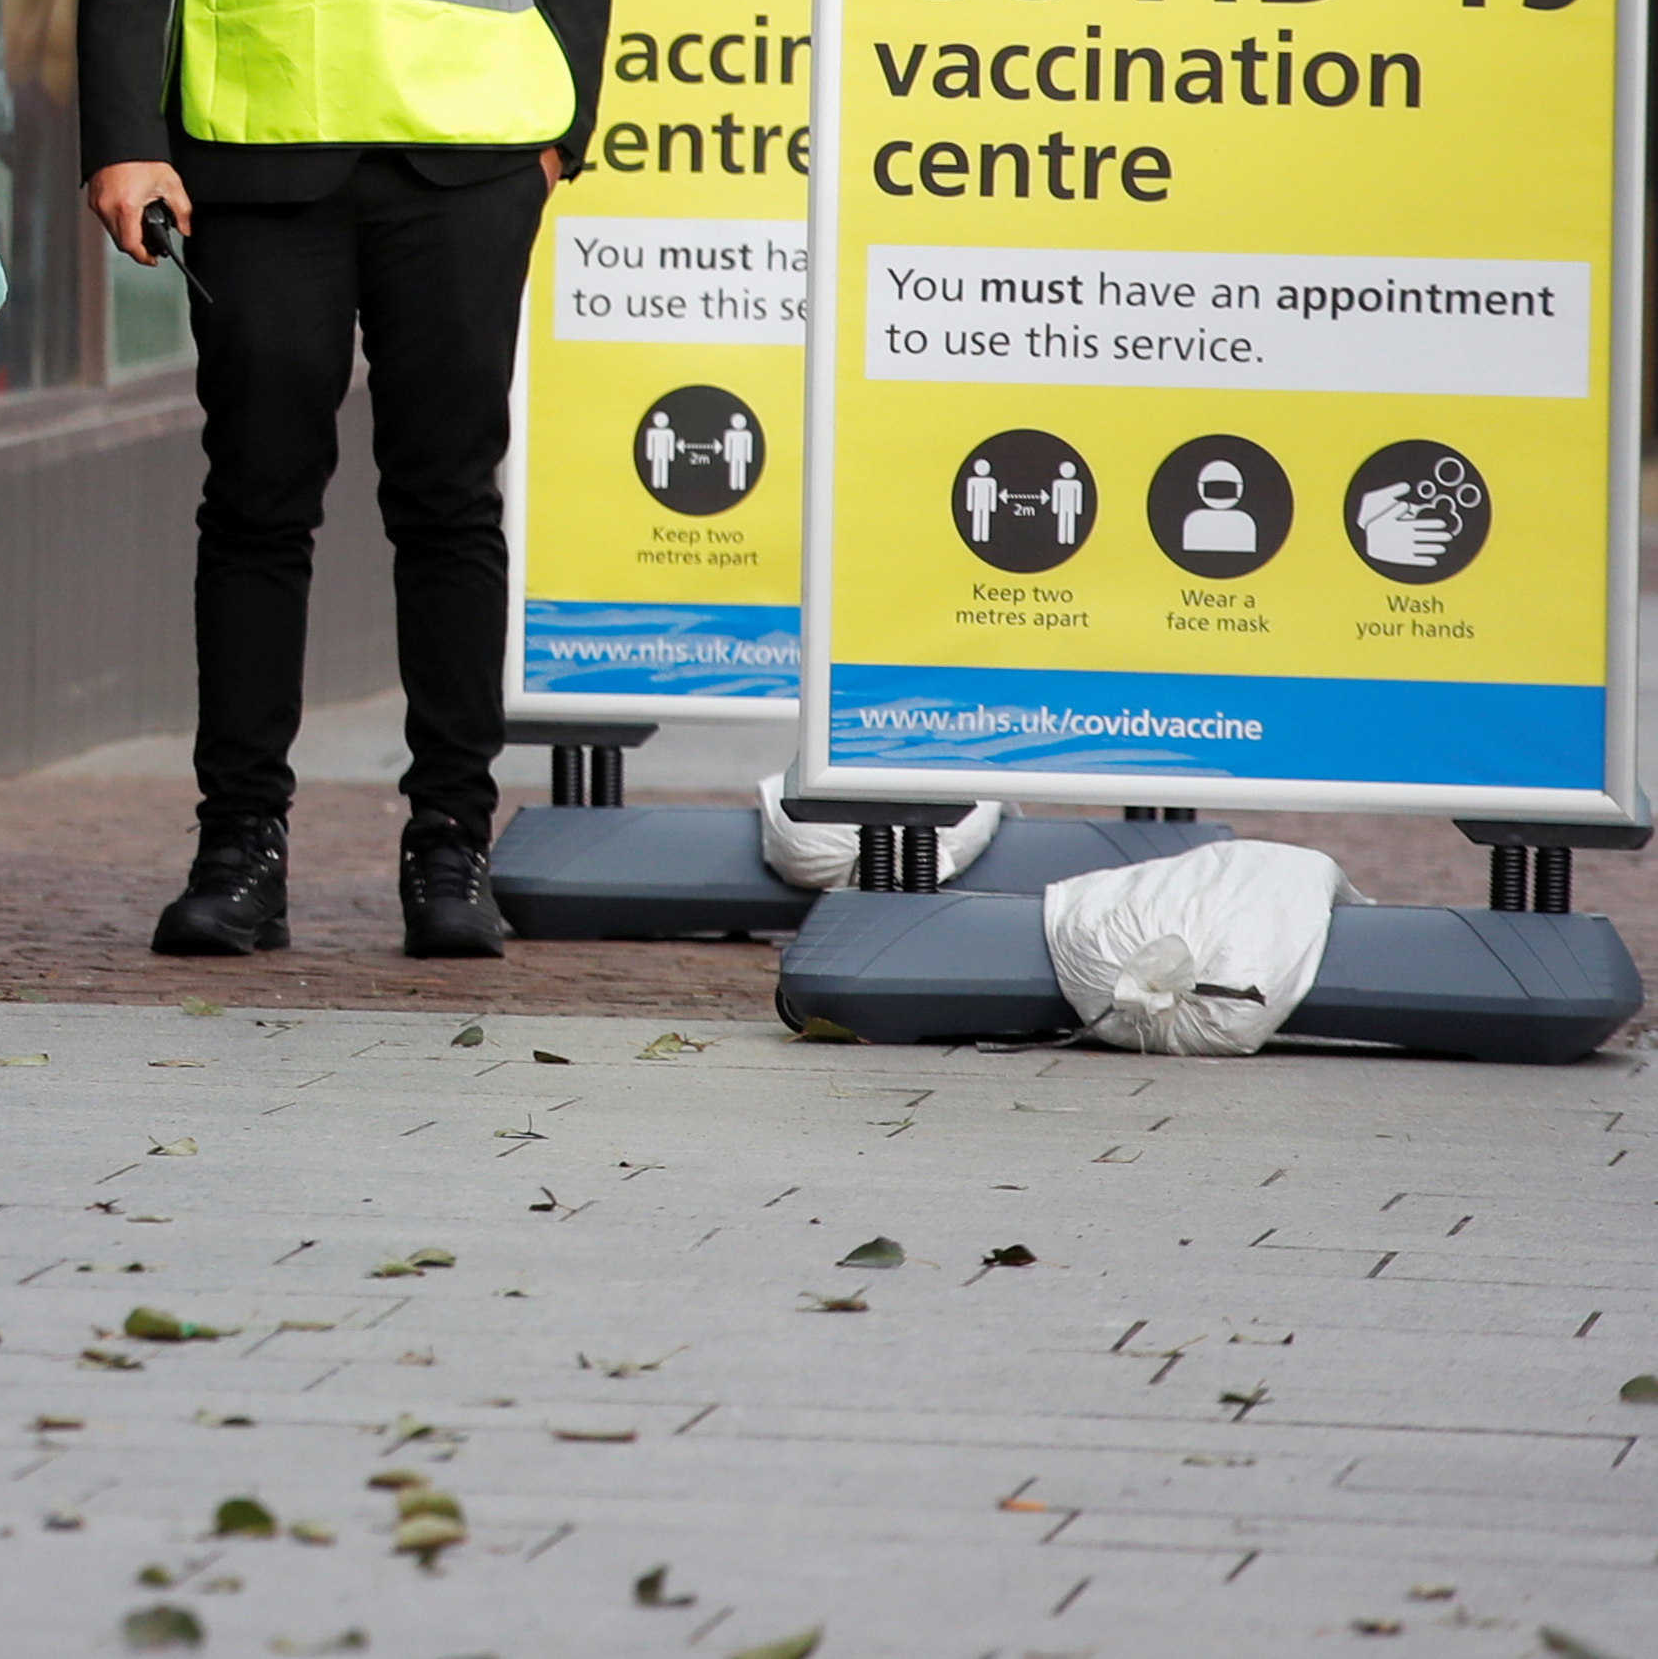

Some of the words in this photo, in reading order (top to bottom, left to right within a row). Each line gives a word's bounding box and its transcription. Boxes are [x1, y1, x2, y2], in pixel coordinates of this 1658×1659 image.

[614, 13, 812, 85] accin
[873, 24, 1423, 110] vaccination
[872, 131, 1173, 202] centre
[573, 236, 644, 269] You
[659, 242, 754, 271] must
[571, 288, 612, 318] to
[626, 293, 687, 319] use
[699, 286, 768, 321] this
[886, 267, 964, 302] You
[981, 274, 1084, 305] must
[1098, 270, 1196, 308] have
[1210, 281, 1261, 310] an
[1276, 277, 1556, 320] appointment
[885, 323, 929, 355] to
[944, 328, 1011, 357] use
[1024, 322, 1100, 360] this
[1112, 327, 1264, 364] service.
[689, 451, 711, 466] 2m
[1012, 503, 1036, 517] 2m
[652, 525, 701, 546] Keep
[707, 527, 744, 544] two
[636, 548, 702, 566] metres
[708, 550, 759, 569] apart
[972, 583, 1026, 606] Keep
[1032, 586, 1074, 604] two
[1180, 588, 1238, 609] Wear
[1243, 593, 1257, 609] a
[1386, 594, 1445, 615] Wash
[955, 608, 1027, 627] metres
[1032, 610, 1090, 631] apart
[1166, 612, 1211, 632] face
[1217, 614, 1271, 634] mask
[1355, 620, 1405, 641] your
[1410, 619, 1476, 640] hands
[549, 638, 801, 667] www.nhs.uk/covi
[858, 703, 1264, 741] www.nhs.uk/covidvaccine
